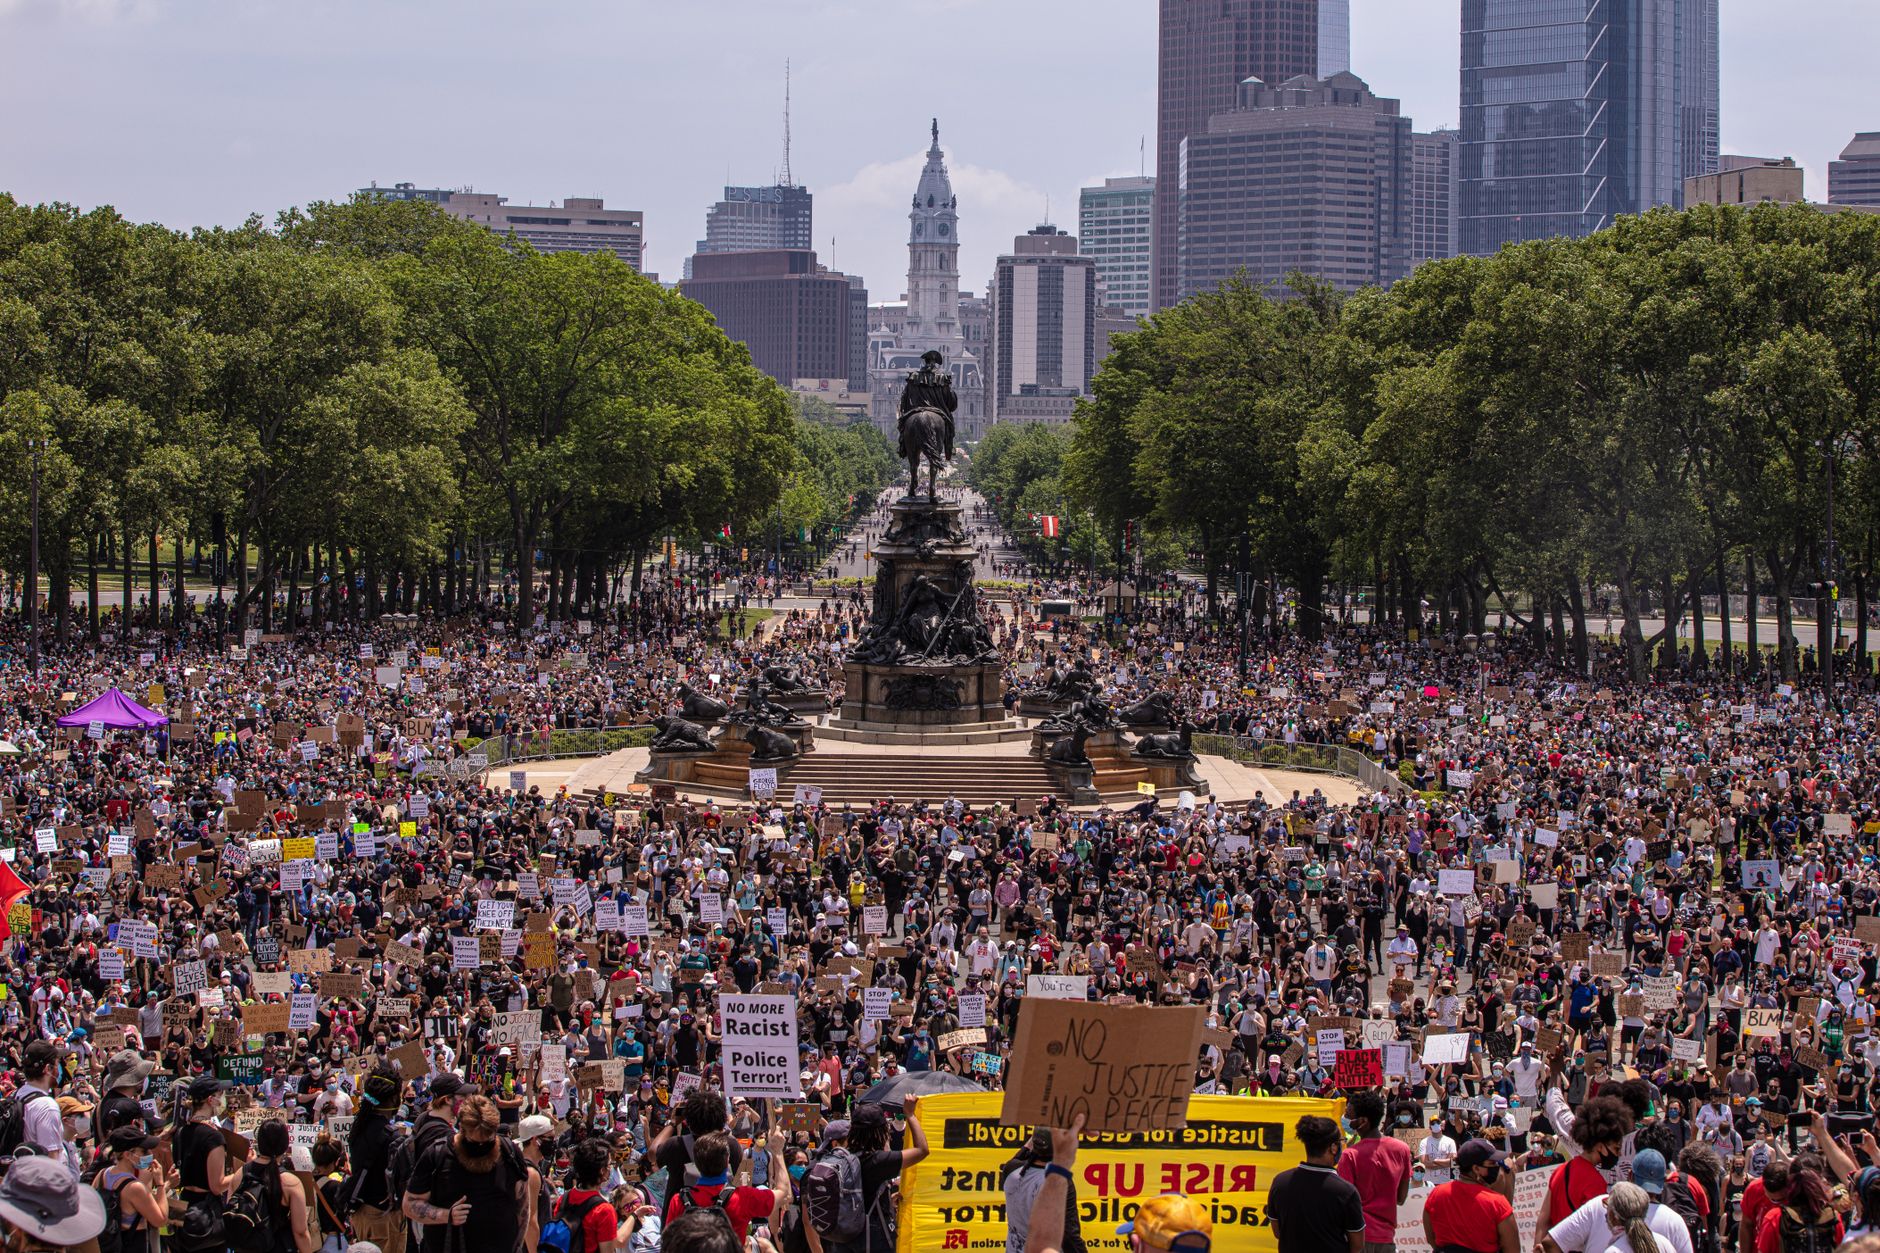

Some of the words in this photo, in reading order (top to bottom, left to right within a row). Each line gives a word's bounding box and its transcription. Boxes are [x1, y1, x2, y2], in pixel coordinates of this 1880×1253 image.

[407, 720, 432, 736] BLM
[753, 782, 776, 790] FLOYD
[227, 844, 246, 855] BLACK
[163, 866, 179, 874] ARE
[146, 878, 179, 888] CHANGE
[479, 900, 496, 909] GET
[498, 902, 514, 910] YOUR
[478, 910, 496, 918] KNEE
[498, 910, 513, 918] OFF
[476, 918, 495, 928] THEIR
[495, 919, 514, 929] NECK
[272, 922, 305, 949] BLM
[257, 944, 278, 952] LIVES
[176, 963, 204, 976] BLACK
[177, 972, 205, 985] LIVES
[1037, 976, 1074, 992] You're
[176, 980, 208, 995] MATTER
[378, 999, 409, 1007] JUSTICE
[726, 1002, 745, 1014] NO
[748, 1004, 785, 1014] MORE
[492, 1015, 508, 1028] NO
[510, 1011, 540, 1024] JUSTICE
[1748, 1010, 1780, 1026] BLM
[424, 1017, 458, 1038] BLM
[726, 1018, 790, 1036] Racist
[492, 1031, 508, 1044] NO
[510, 1022, 540, 1041] PEACE
[1373, 1031, 1388, 1041] BLM
[947, 1036, 981, 1046] MATTER
[1063, 1018, 1106, 1061] NO
[223, 1057, 262, 1068] DEFUND
[472, 1055, 498, 1066] BLACK
[732, 1052, 787, 1068] Police
[976, 1052, 1000, 1062] BLACK
[1338, 1051, 1379, 1064] BLACK
[972, 1064, 998, 1074] MATTER
[976, 1059, 998, 1068] LIVES
[230, 1068, 254, 1078] THE
[470, 1064, 498, 1075] LIVES
[1338, 1064, 1369, 1075] LIVES
[470, 1073, 502, 1085] MATTER
[678, 1075, 700, 1084] WHITE
[731, 1070, 788, 1084] Terror!
[1083, 1061, 1192, 1099] JUSTICE
[1338, 1073, 1376, 1086] MATTER
[1198, 1085, 1212, 1094] STOP
[1051, 1096, 1090, 1129] NO
[1104, 1097, 1184, 1130] PEACE
